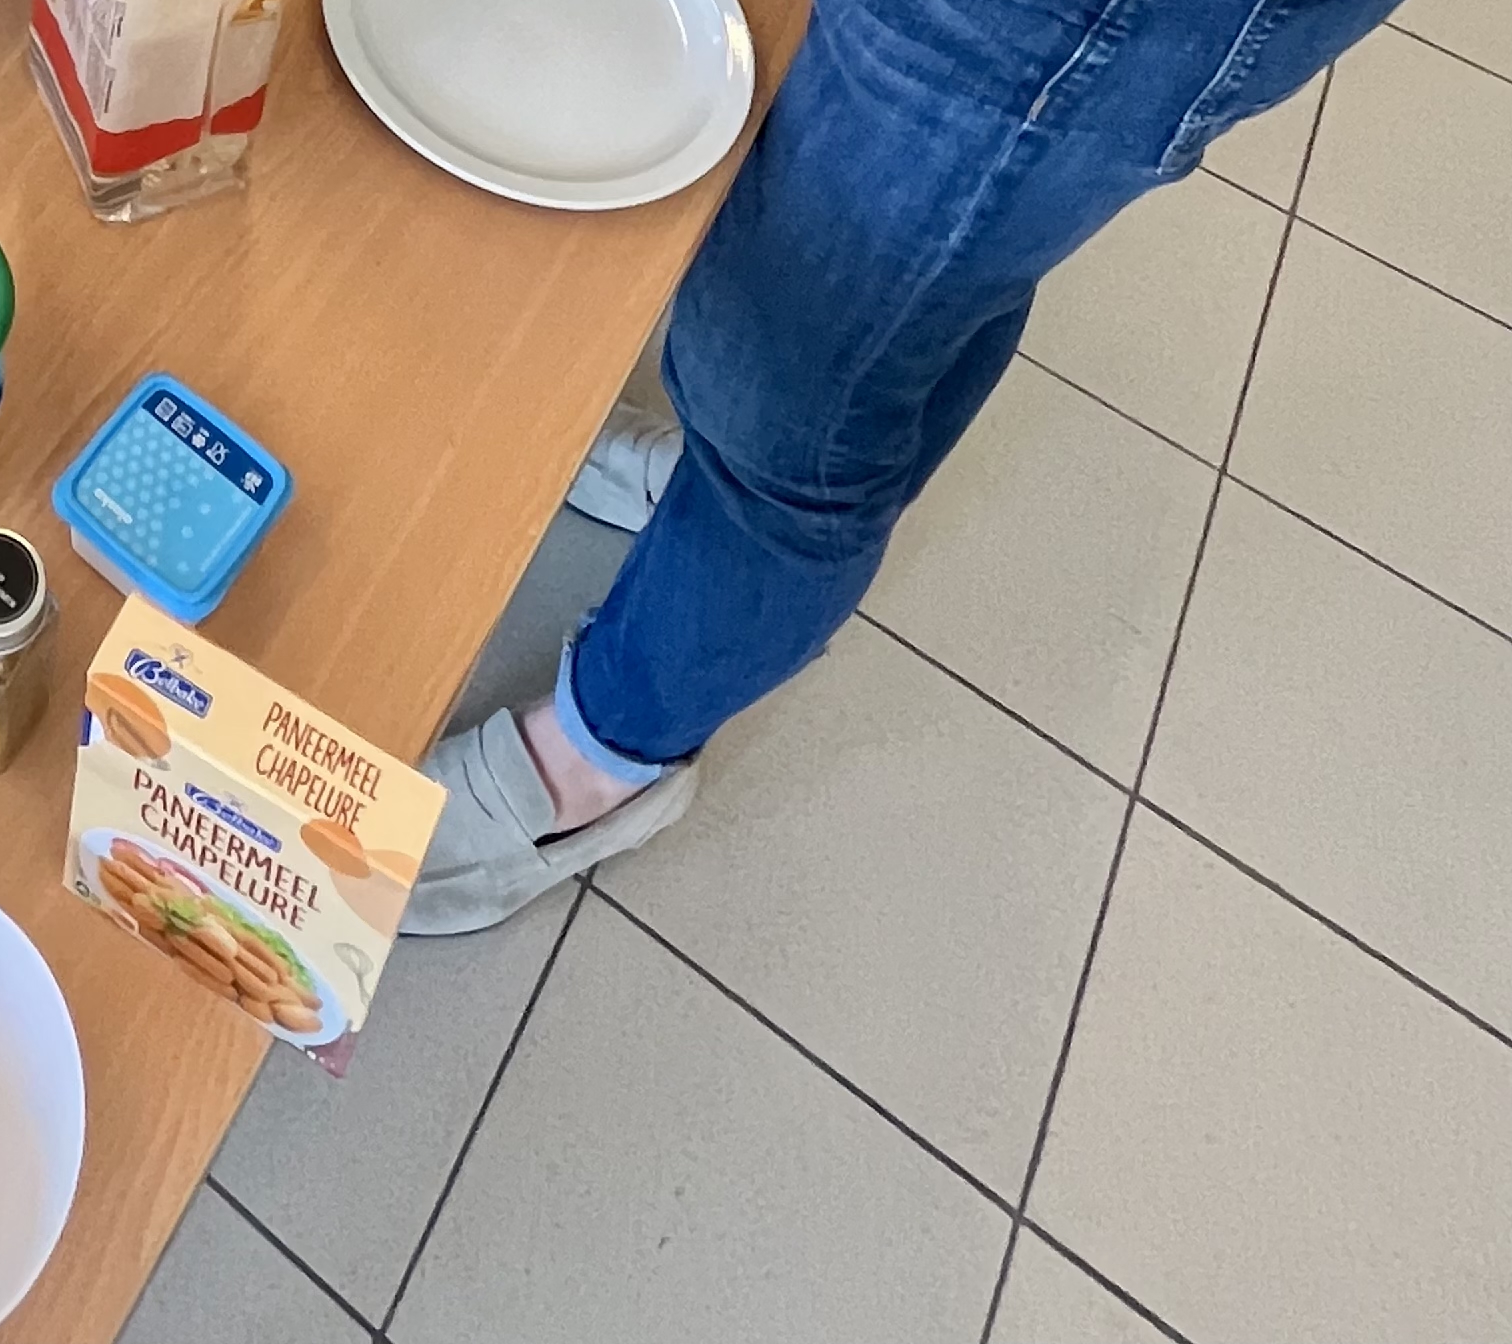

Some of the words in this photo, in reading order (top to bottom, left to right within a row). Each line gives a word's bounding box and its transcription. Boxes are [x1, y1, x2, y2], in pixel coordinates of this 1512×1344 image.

[256, 743, 367, 835] CHAPELURE
[262, 701, 382, 801] PANEERMEEL
[133, 767, 322, 914] PANEERMEEL
[140, 803, 305, 931] CHAPELURE
